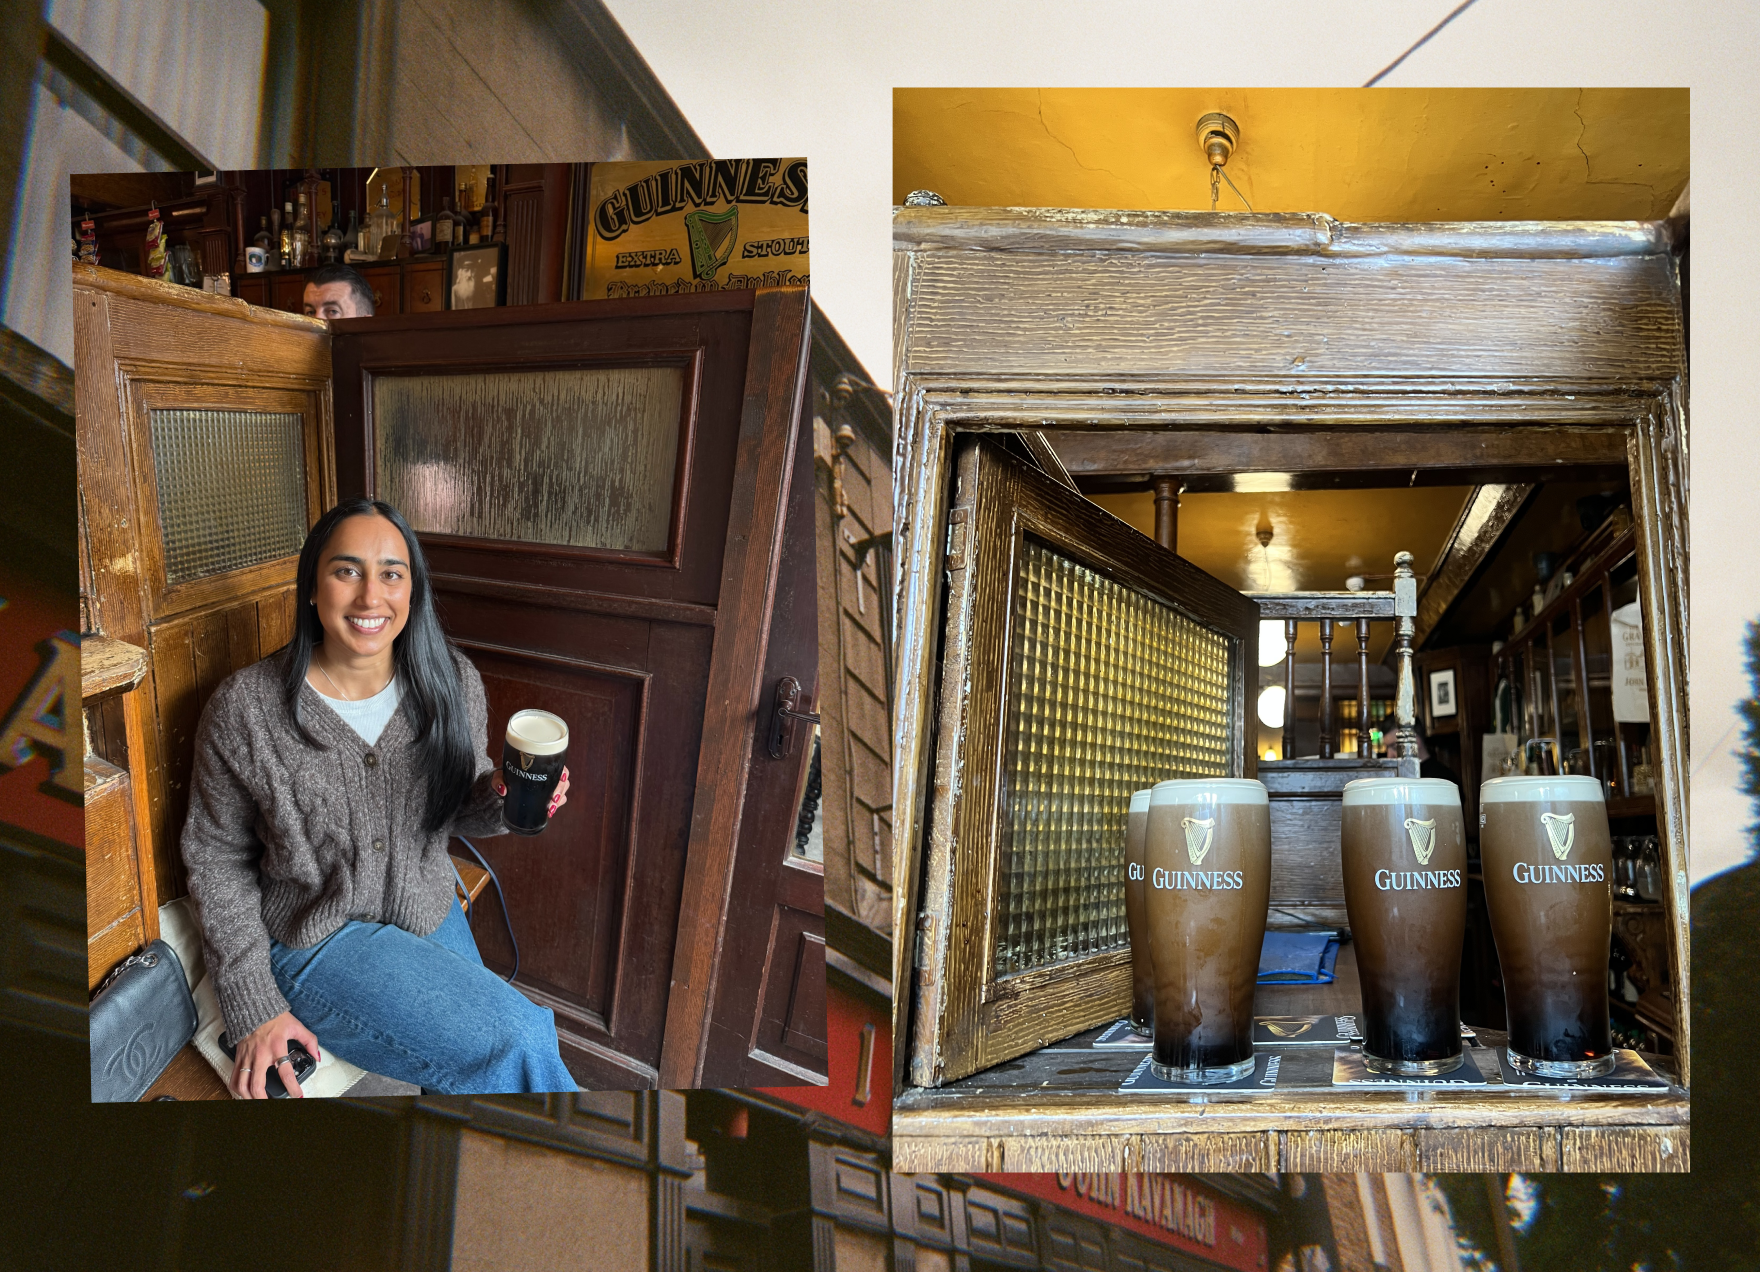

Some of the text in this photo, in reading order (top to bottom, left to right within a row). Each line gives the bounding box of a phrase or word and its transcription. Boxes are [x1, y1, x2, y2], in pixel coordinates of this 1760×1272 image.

[594, 158, 808, 241] GUINNES
[615, 236, 809, 269] EXTRA STOUT
[505, 761, 547, 781] GUINNESS
[1152, 867, 1243, 890] GUINNESS
[1374, 869, 1461, 891] GUINNESS
[1512, 862, 1605, 884] GUINNESS
[1259, 1055, 1282, 1085] GUINNESS
